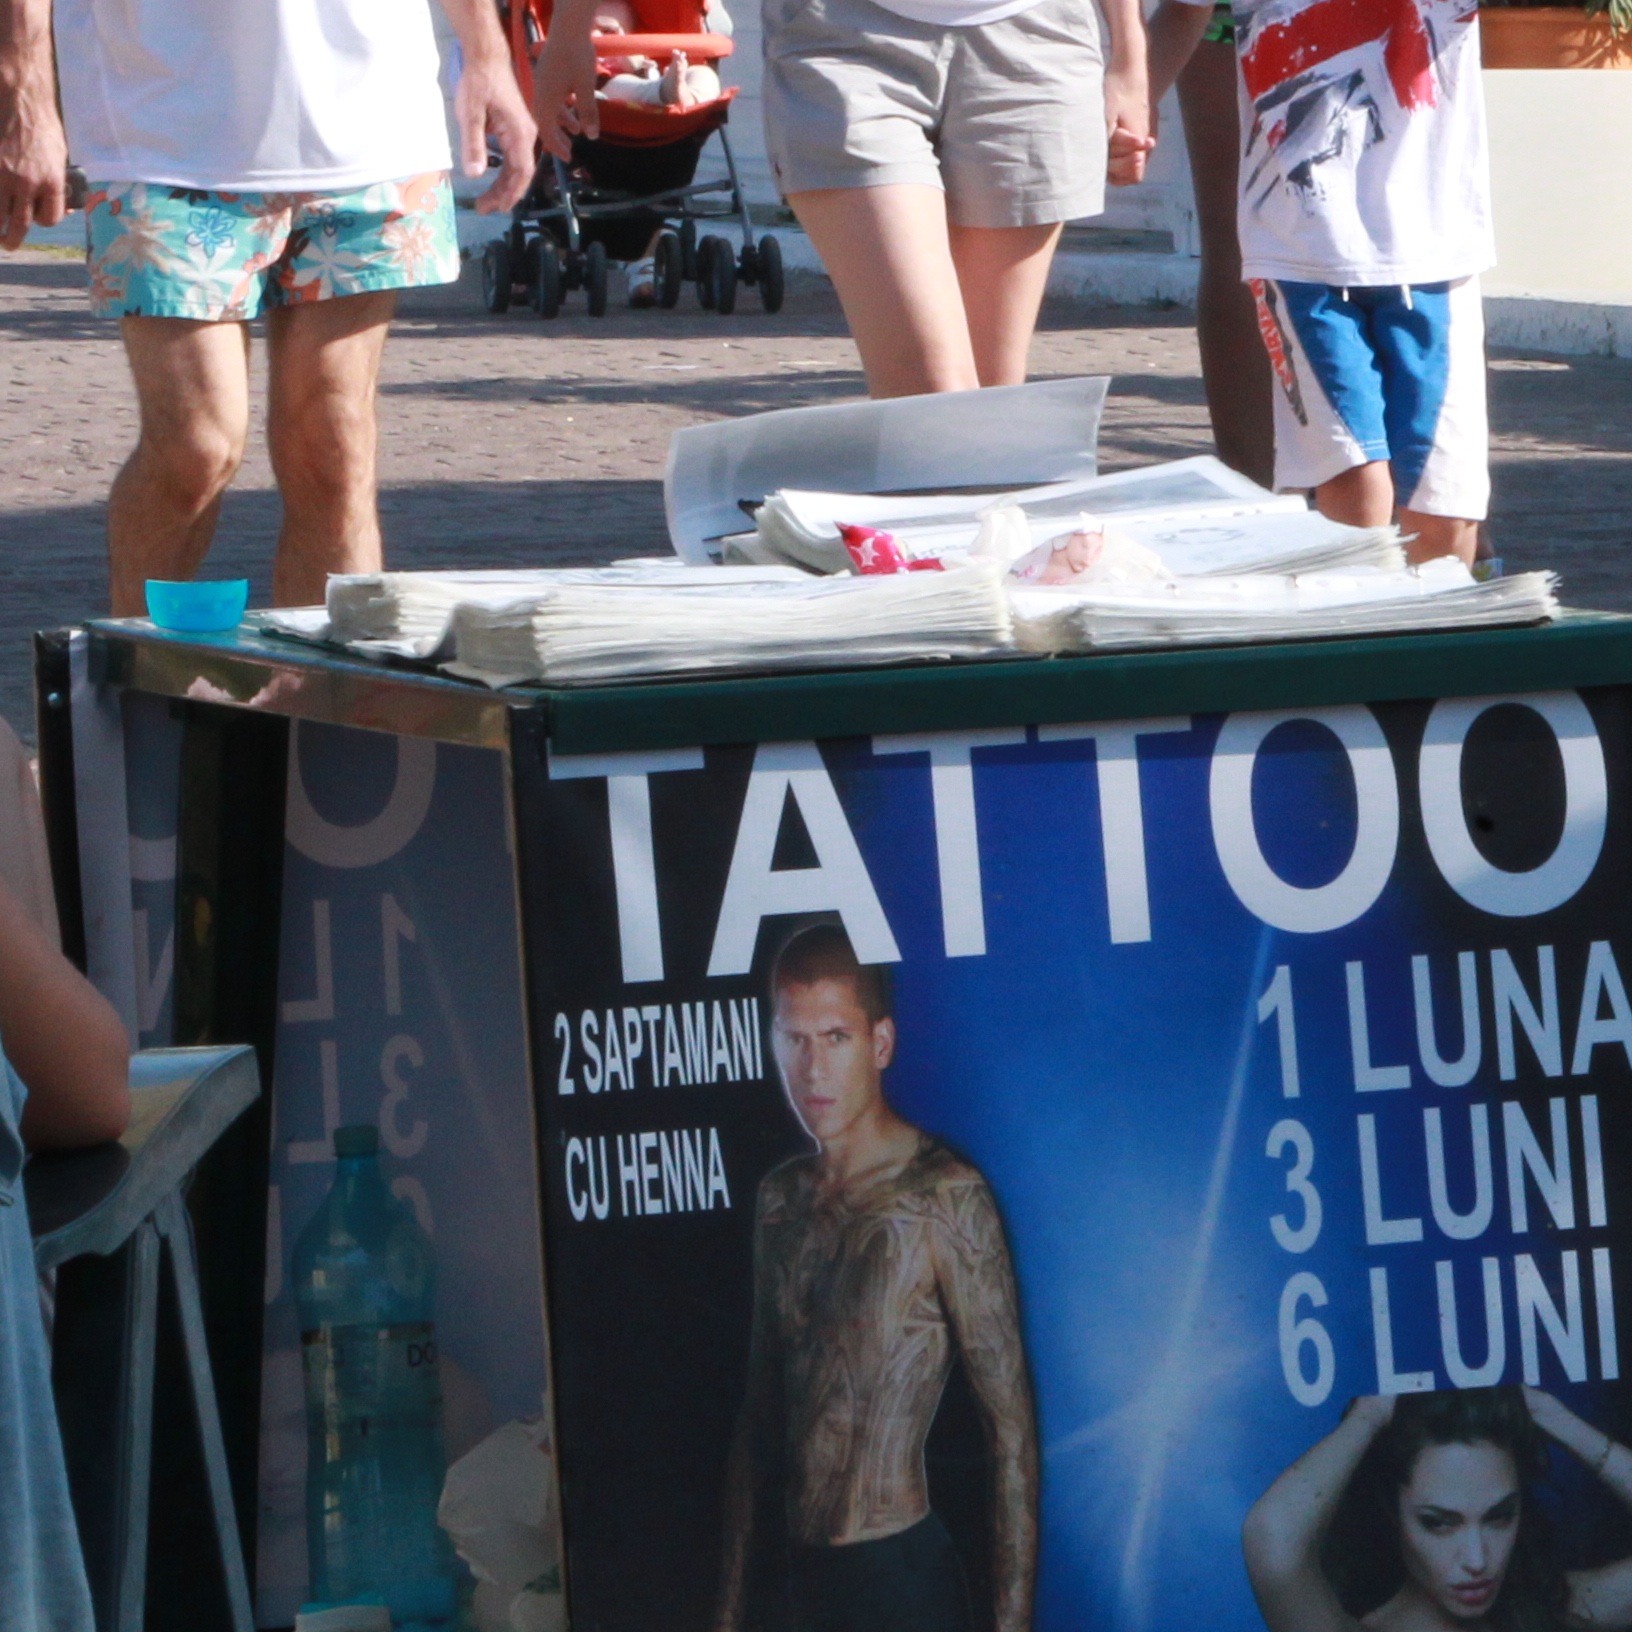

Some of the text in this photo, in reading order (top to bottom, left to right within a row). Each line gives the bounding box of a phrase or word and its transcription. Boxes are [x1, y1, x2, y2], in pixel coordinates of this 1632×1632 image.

[548, 688, 1608, 983] TATTOO
[555, 996, 764, 1095] 2 SAPTAMANI
[1258, 965, 1299, 1099] 1
[565, 1126, 731, 1223] CU HENNA
[1268, 1094, 1608, 1252] 3 LUNI
[1280, 1247, 1619, 1408] 6 LUNI
